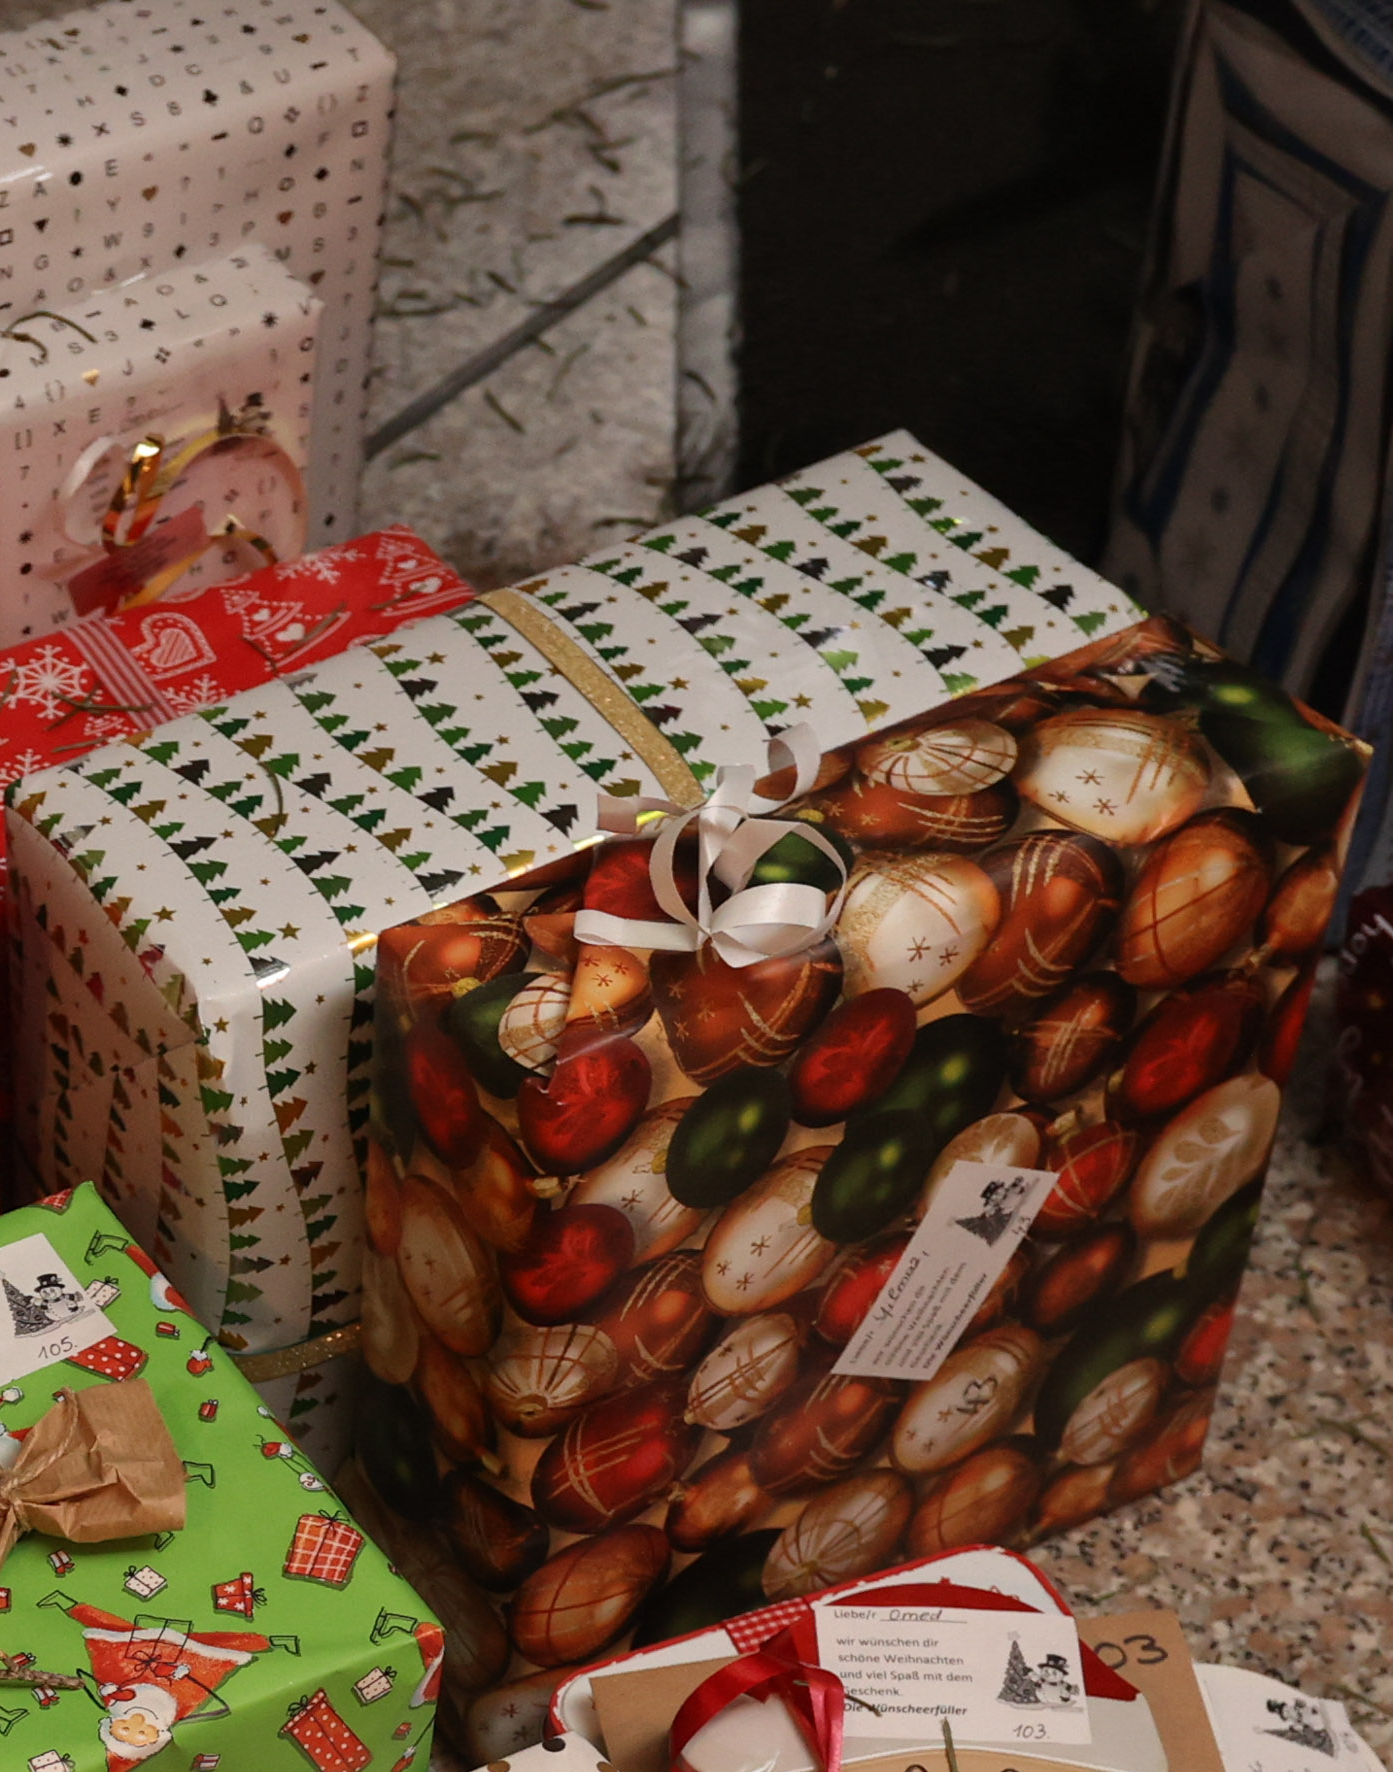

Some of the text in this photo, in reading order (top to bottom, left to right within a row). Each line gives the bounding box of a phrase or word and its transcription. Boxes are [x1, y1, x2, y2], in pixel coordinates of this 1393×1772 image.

[833, 1609, 877, 1621] Liebe/r
[887, 1608, 944, 1623] Omed
[836, 1637, 939, 1648] wir wünschen dir
[838, 1653, 964, 1666] schöne Weihnachten
[838, 1669, 973, 1683] und viel Spaß mit dem
